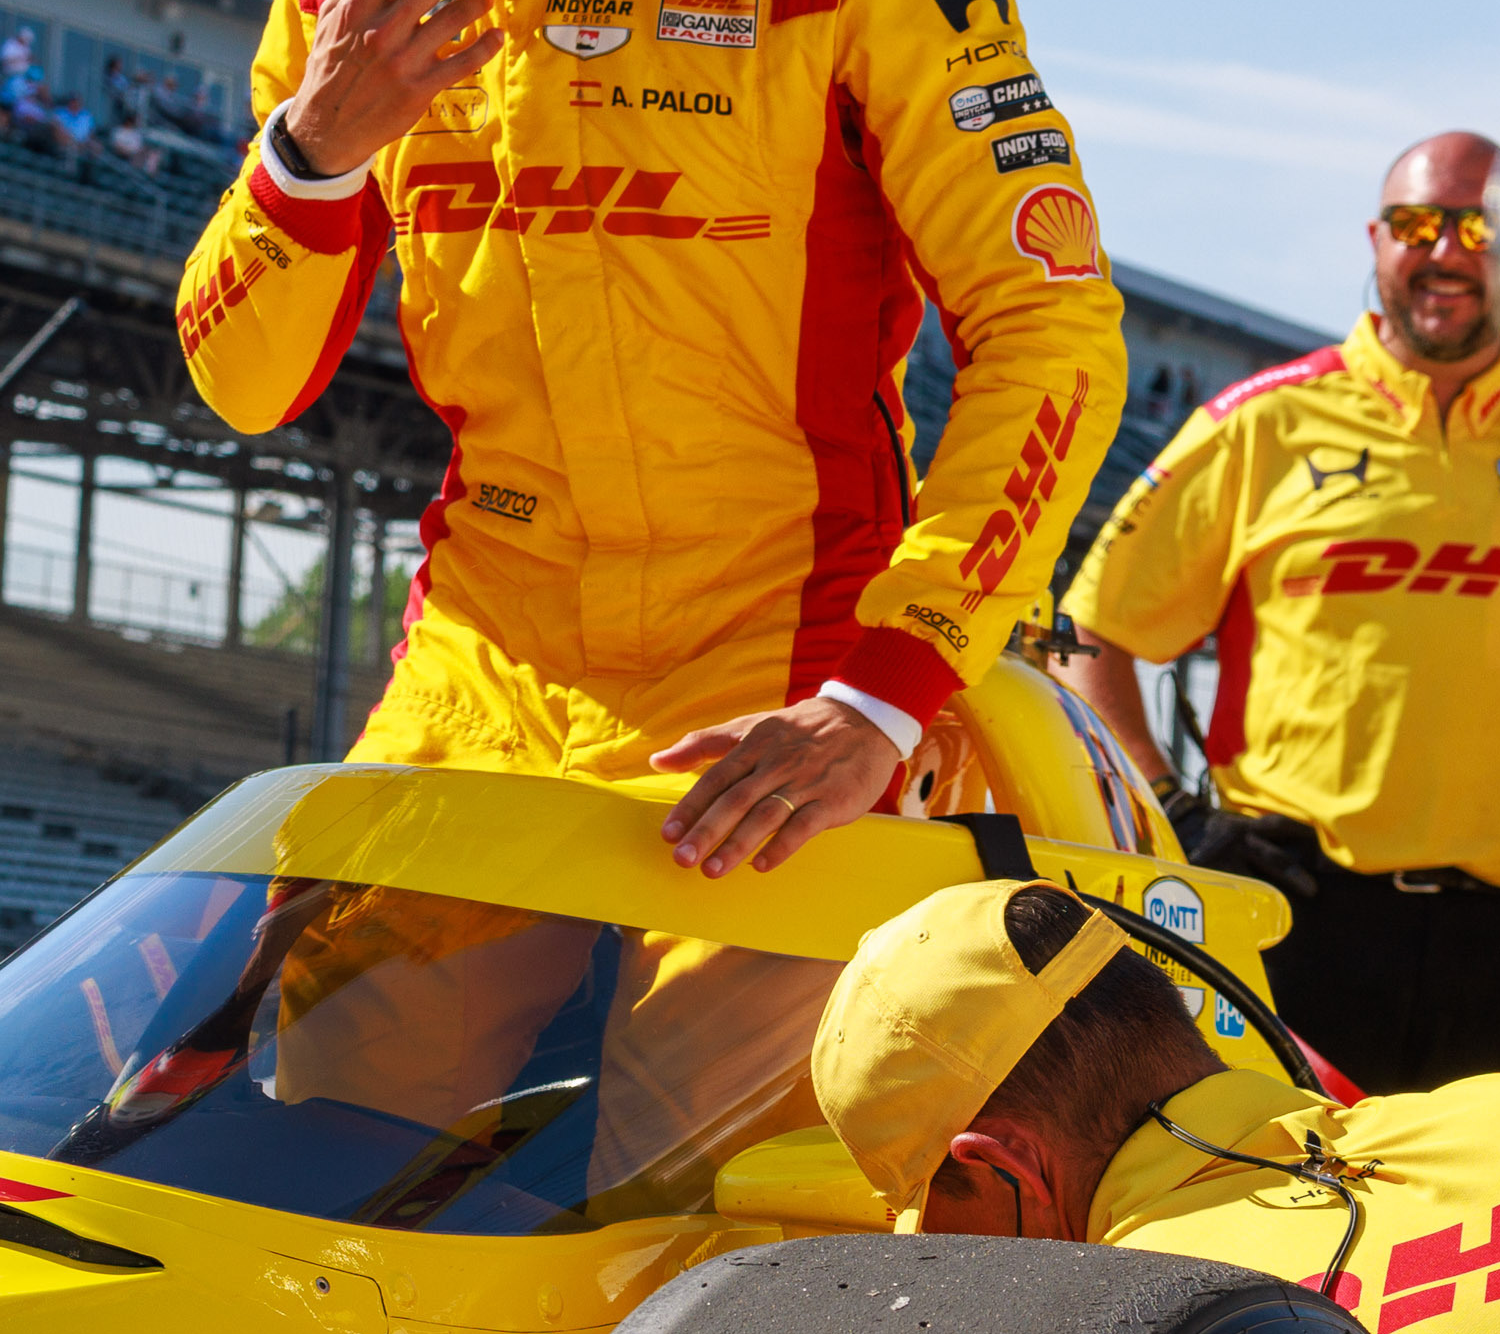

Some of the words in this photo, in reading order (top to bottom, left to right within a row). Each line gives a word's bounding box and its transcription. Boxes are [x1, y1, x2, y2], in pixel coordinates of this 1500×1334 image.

[561, 13, 612, 25] SERIES
[681, 14, 753, 34] GANASSI
[660, 26, 753, 45] RACING
[610, 85, 634, 109] A.
[641, 88, 733, 116] PALOU
[992, 78, 1044, 105] CHAM
[997, 133, 1038, 159] INDY
[1039, 131, 1067, 148] 500
[404, 160, 709, 240] DHL
[478, 482, 538, 519] sparco
[958, 392, 1083, 598] DHL
[905, 602, 969, 650] sparco
[1169, 904, 1199, 931] NTT
